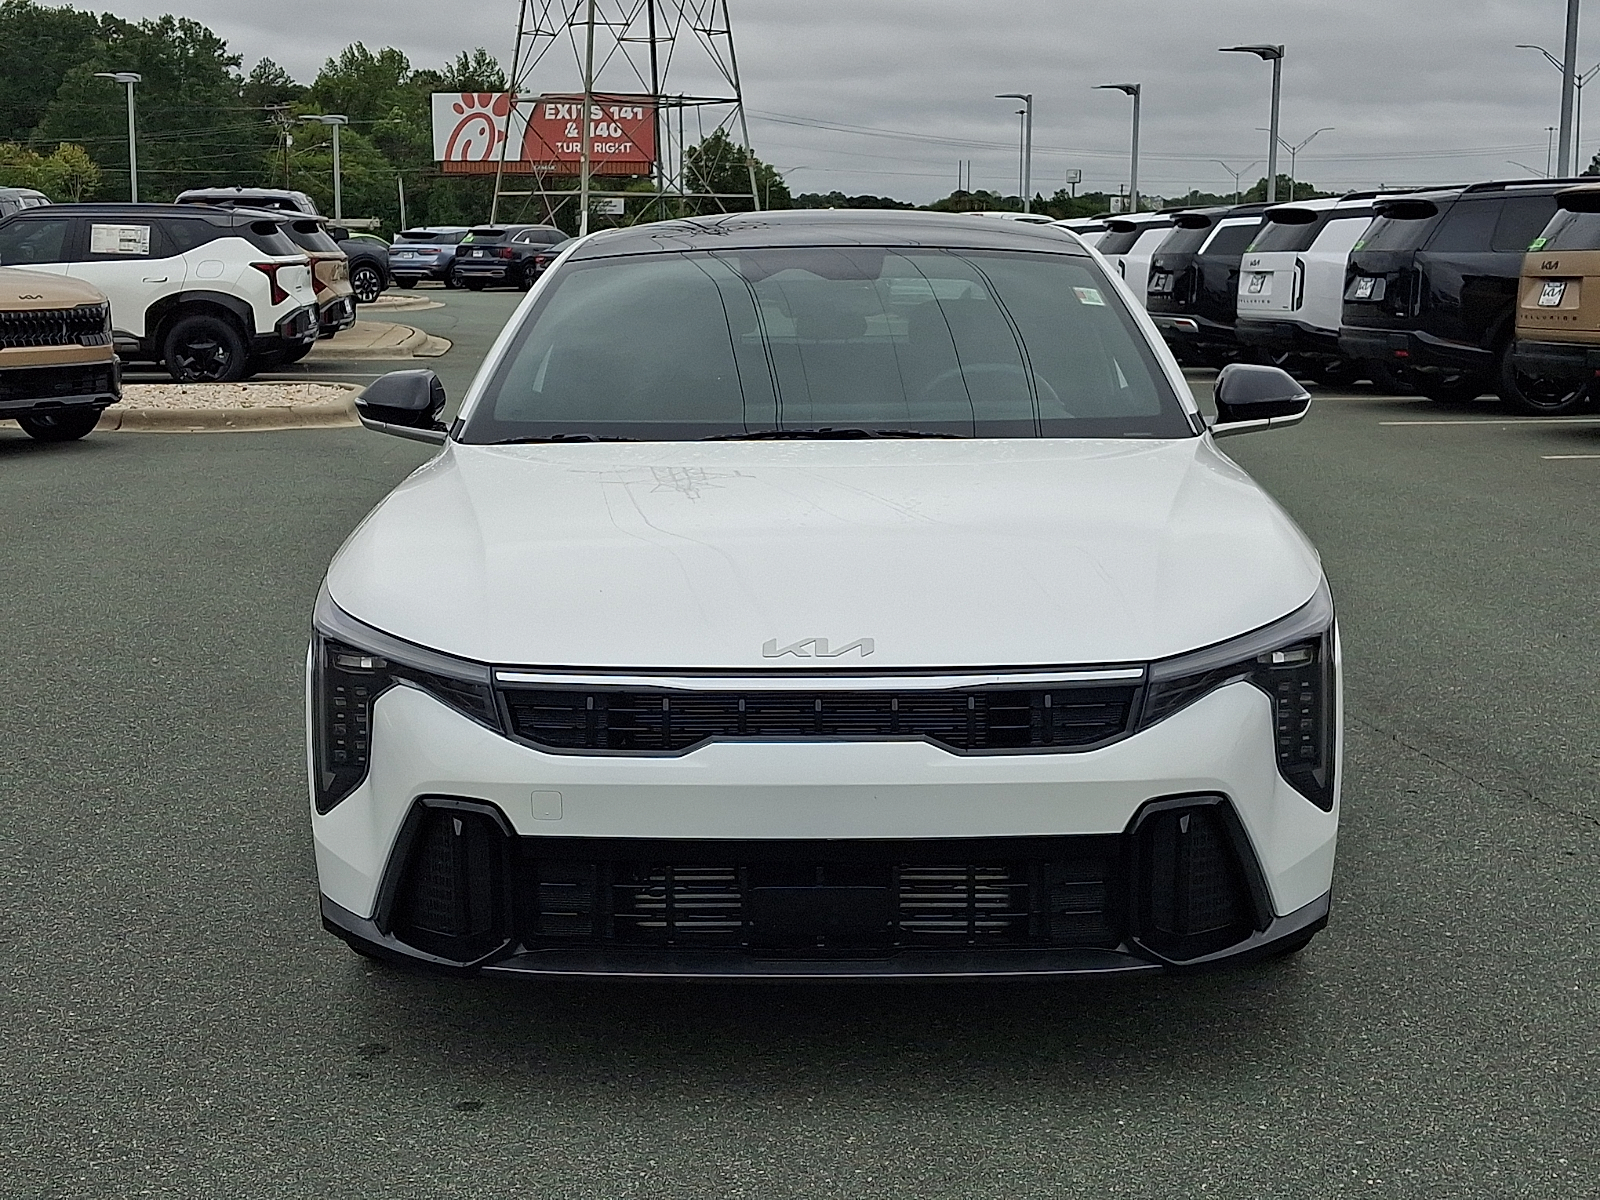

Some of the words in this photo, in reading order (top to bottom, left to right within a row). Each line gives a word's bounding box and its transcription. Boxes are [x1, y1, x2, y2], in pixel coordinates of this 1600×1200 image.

[610, 106, 643, 120] 141
[565, 121, 579, 138] &
[589, 121, 622, 138] 140
[556, 142, 588, 153] TUR
[594, 142, 632, 153] RIGHT
[1541, 261, 1559, 270] KIA
[762, 637, 875, 658] KIA
